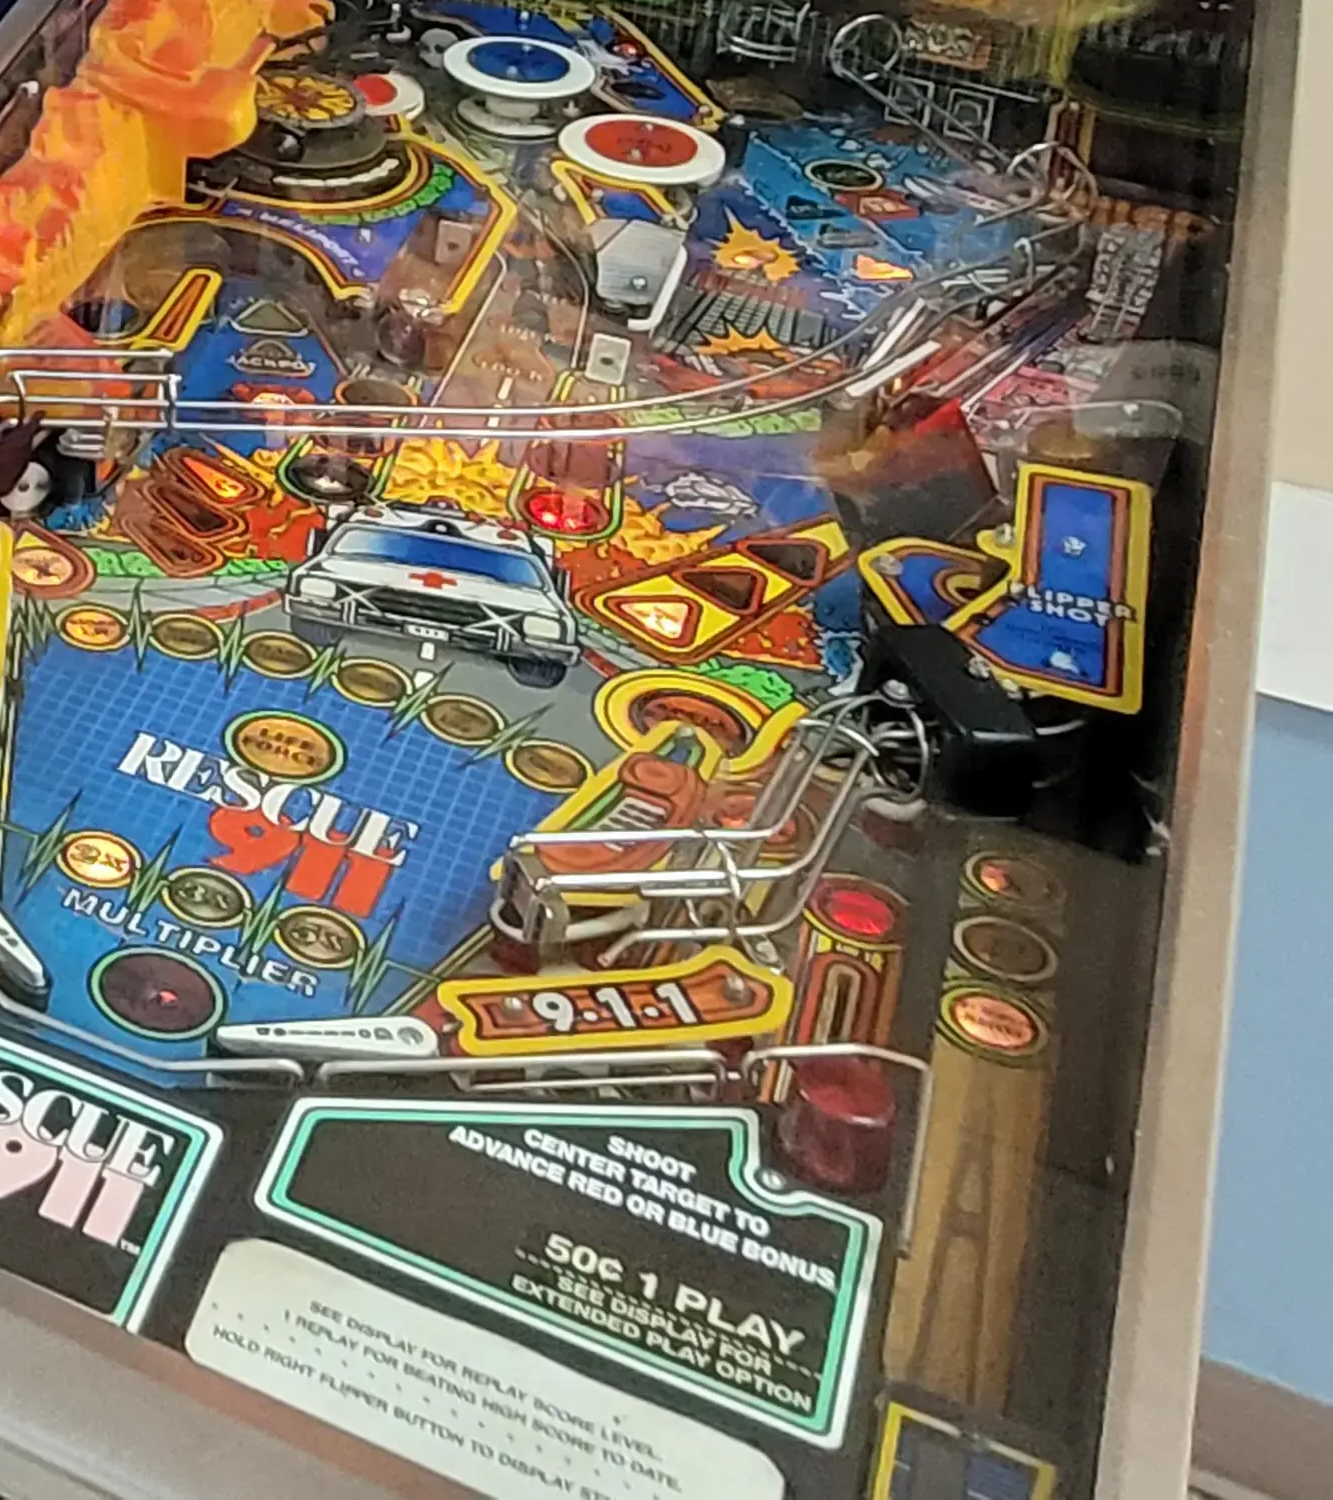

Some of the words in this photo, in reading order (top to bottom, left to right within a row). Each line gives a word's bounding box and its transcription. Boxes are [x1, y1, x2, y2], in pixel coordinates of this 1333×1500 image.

[117, 731, 422, 868] RESCUE
[206, 803, 393, 920] 911
[61, 888, 322, 997] MULTIPLIER
[449, 1124, 565, 1184] ADVANCE
[567, 1170, 625, 1207] RED
[626, 1193, 669, 1223] OR
[668, 1209, 740, 1252] BLUE
[740, 1237, 838, 1289] BONUS
[523, 1128, 630, 1182] CENTER
[629, 1167, 731, 1222] TARGET
[735, 1206, 772, 1239] TO
[608, 1135, 699, 1183] SHOOT
[511, 1274, 642, 1339] EXTENDED
[645, 1329, 716, 1374] PLAY
[716, 1358, 812, 1413] OPTION
[544, 1233, 626, 1282] 50¢
[640, 1271, 660, 1302] 1
[674, 1284, 807, 1356] PLAY
[556, 1274, 603, 1308] SEE
[611, 1296, 719, 1353] DISPLAY
[719, 1339, 773, 1377] FOR
[210, 1323, 262, 1355] HOLD
[262, 1342, 317, 1379] RIGHT
[318, 1371, 390, 1418] FLIPPER
[392, 1401, 468, 1448] BUTTON
[471, 1437, 495, 1461] TO
[497, 1447, 577, 1492] DISPLAY
[294, 1314, 361, 1358] REPLAY
[361, 1342, 400, 1371] FOR
[401, 1359, 478, 1405] BEATING
[480, 1393, 531, 1428] HIGH
[530, 1416, 599, 1457] SCORE
[601, 1447, 628, 1471] TO
[308, 1299, 341, 1322] SEE
[345, 1315, 420, 1361] DISPLAY
[420, 1347, 457, 1373] FOR
[461, 1362, 531, 1404] REPLAY
[532, 1393, 597, 1434] SCORE
